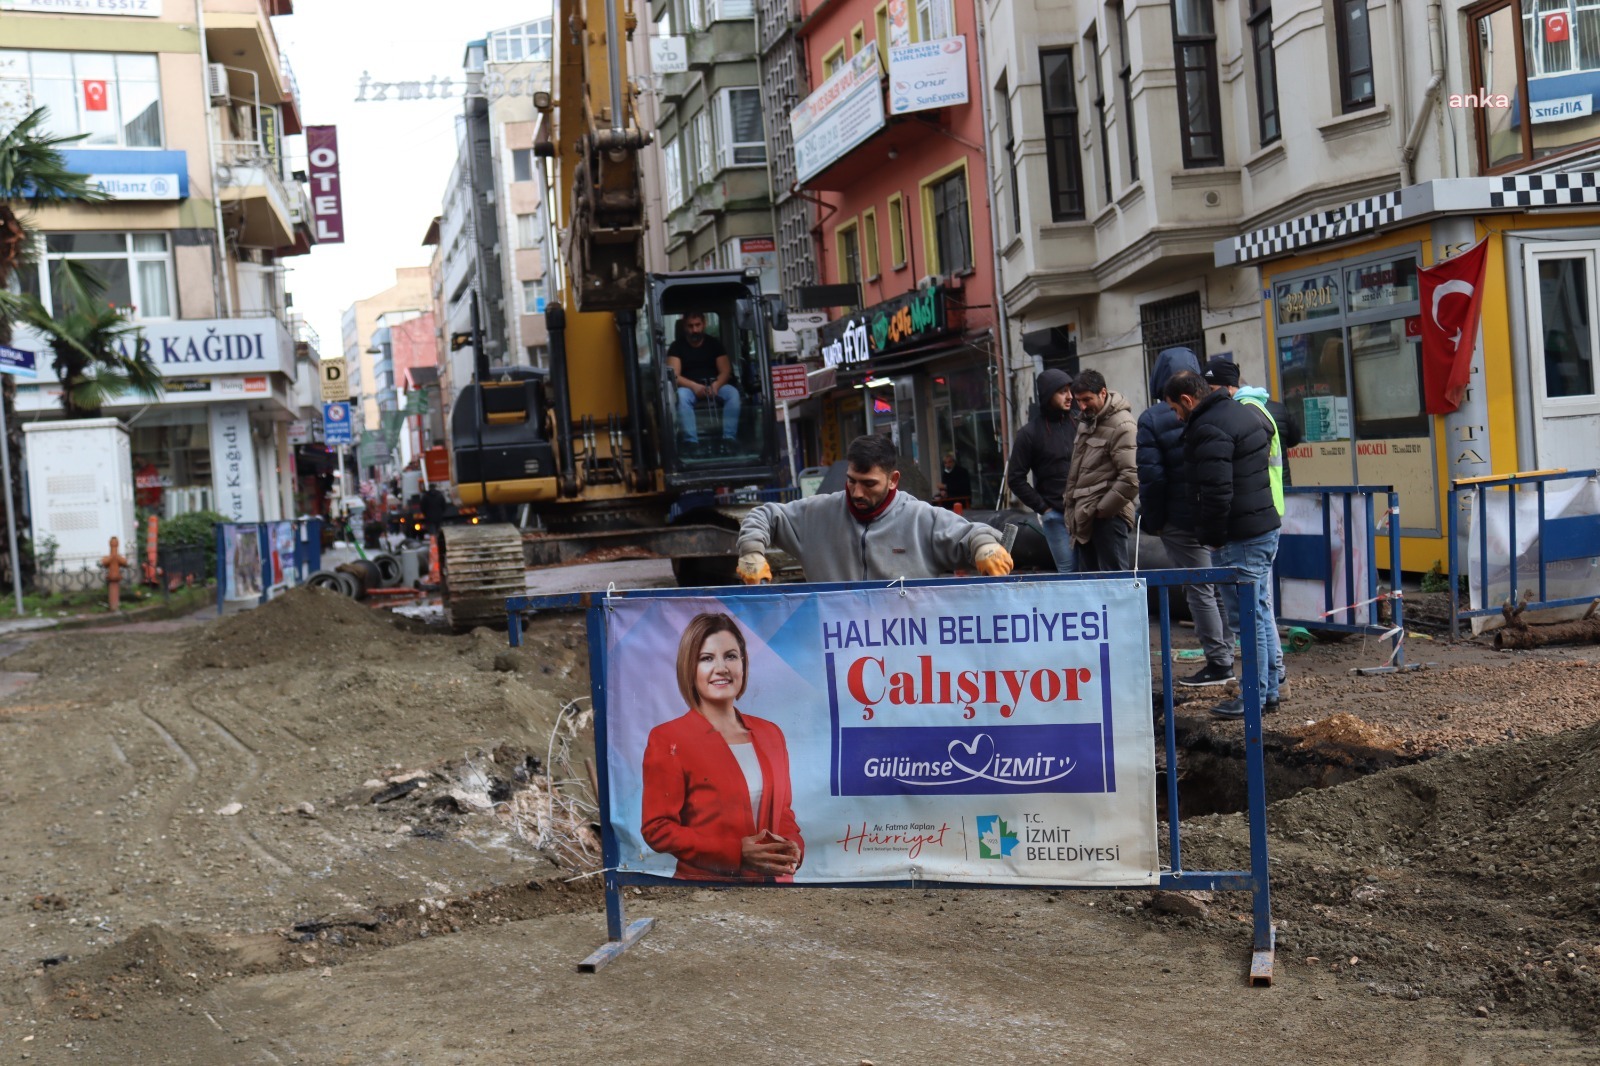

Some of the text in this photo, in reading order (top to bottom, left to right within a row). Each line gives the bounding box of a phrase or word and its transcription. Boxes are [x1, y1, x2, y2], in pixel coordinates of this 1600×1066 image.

[893, 44, 940, 56] TURKISH
[893, 51, 941, 62] AIRLINES
[914, 79, 948, 89] Onur
[916, 91, 965, 104] SunExpress
[96, 180, 147, 193] Allianz
[310, 148, 339, 238] OTEL
[1286, 290, 1304, 313] 322
[1305, 288, 1318, 308] 92
[1320, 285, 1332, 306] 01
[161, 327, 265, 364] KAĞIDI
[326, 366, 341, 380] D
[1357, 441, 1387, 456] KOCAELİ
[823, 604, 1109, 650] HALKIN BELEDİYESİ
[846, 655, 1091, 721] Çalışıyor
[864, 752, 1056, 778] Gülümse İZMİT
[1023, 813, 1044, 823] T.C.
[885, 823, 908, 831] Fatma
[909, 822, 935, 832] Kaplan
[1026, 826, 1071, 843] İZMİT
[836, 821, 951, 860] Hürriyet
[1026, 845, 1120, 861] BELEDİYESİ
